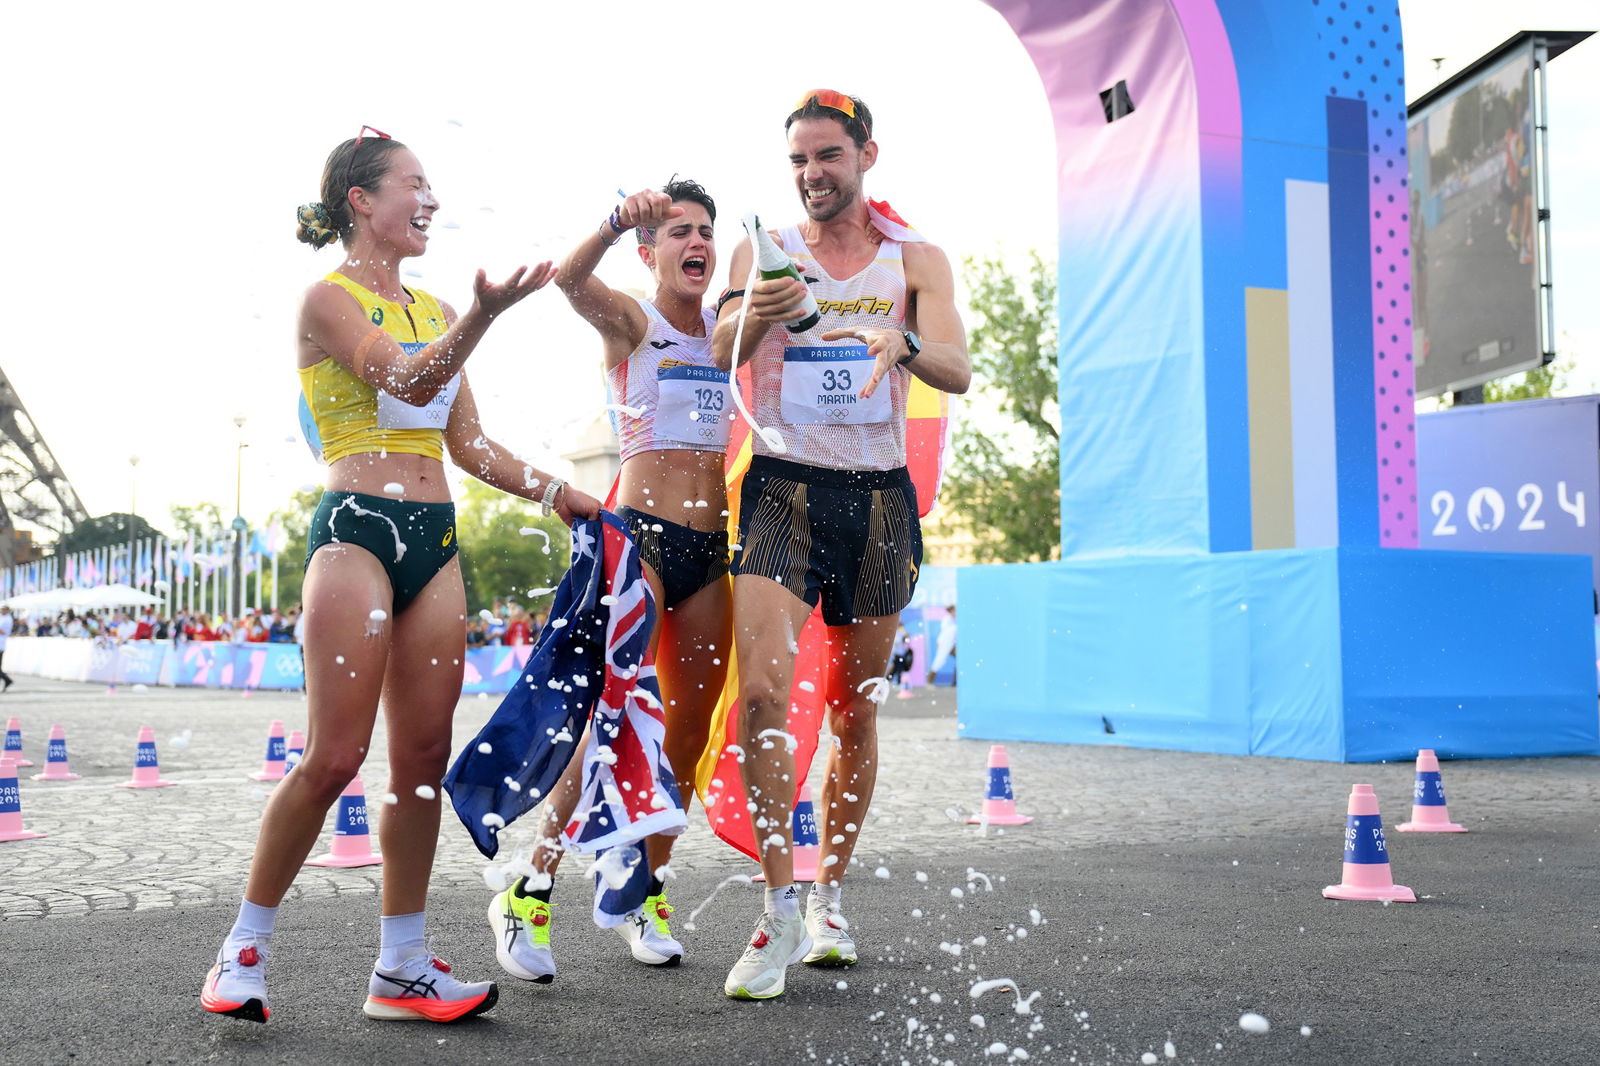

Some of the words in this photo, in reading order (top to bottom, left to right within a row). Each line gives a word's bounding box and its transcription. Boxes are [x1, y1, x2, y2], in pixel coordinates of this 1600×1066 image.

[811, 350, 836, 358] PARIS
[839, 349, 861, 357] 2024
[687, 368, 712, 378] PARIS
[822, 369, 852, 391] 33
[694, 388, 724, 411] 123
[817, 394, 857, 404] MARTIN
[1430, 480, 1586, 537] 2024
